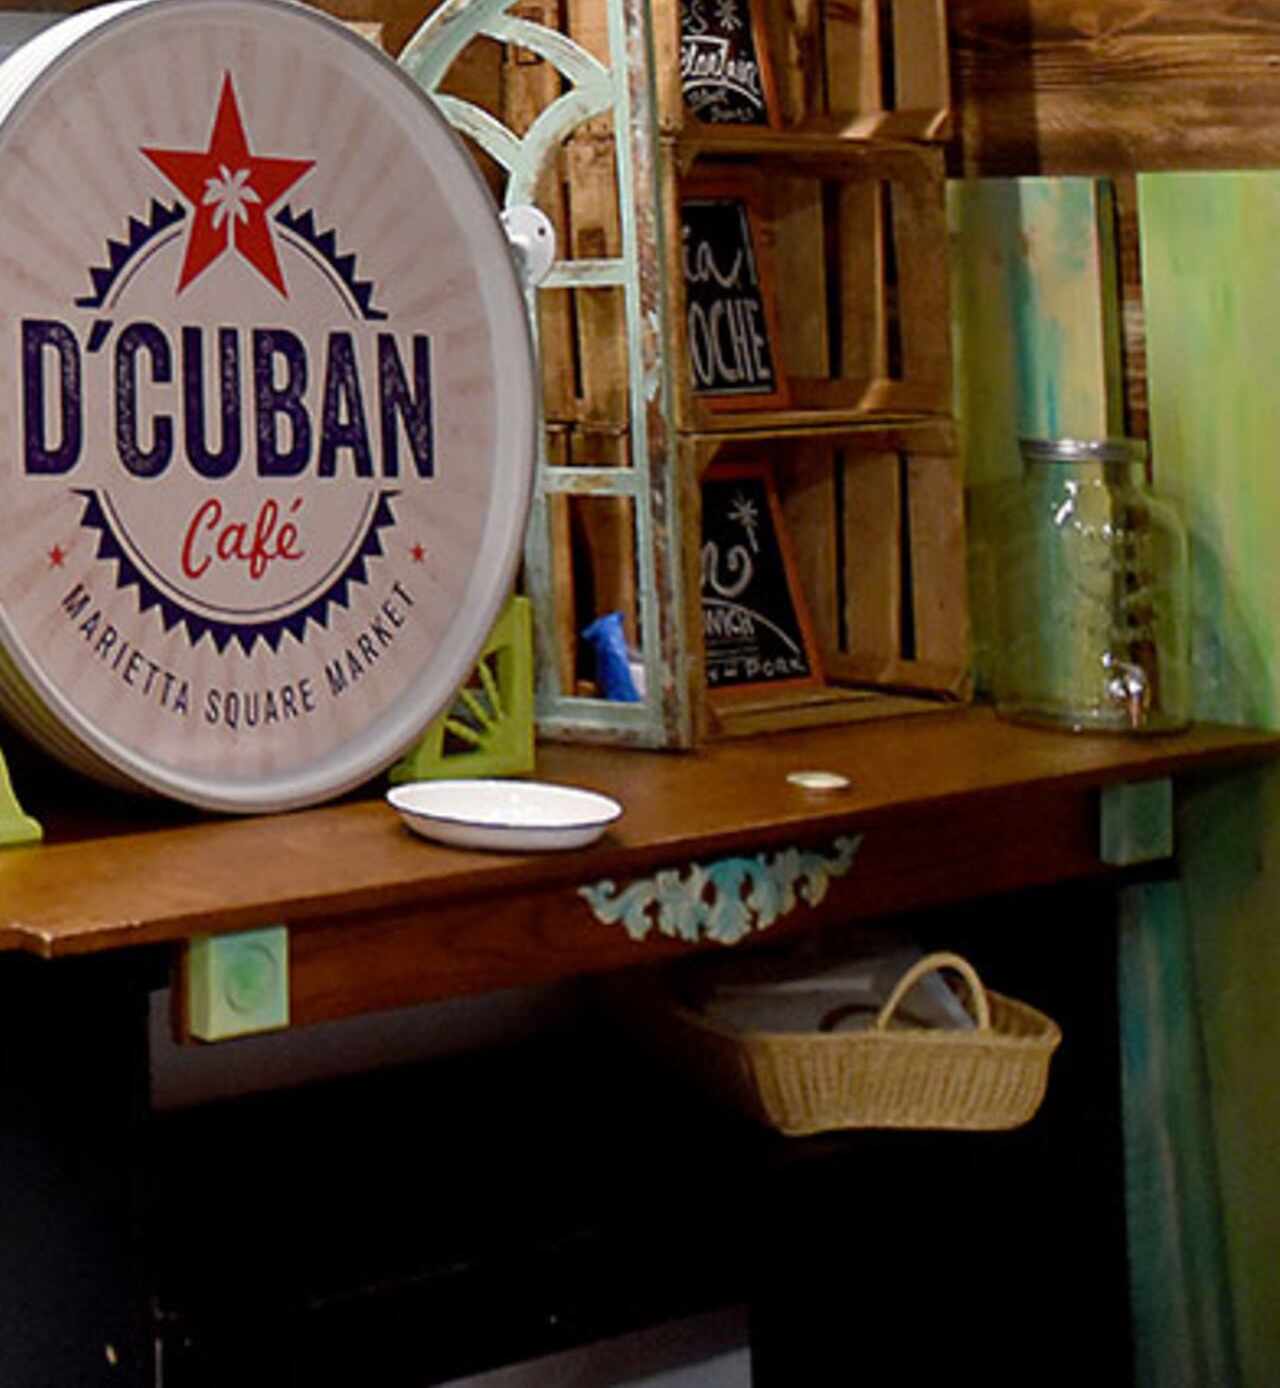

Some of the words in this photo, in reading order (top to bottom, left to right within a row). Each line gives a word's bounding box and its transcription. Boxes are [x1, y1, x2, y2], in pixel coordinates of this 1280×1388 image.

[181, 498, 305, 580] Café
[61, 582, 190, 714] MARIETTA
[205, 676, 317, 729] SQUARE
[323, 580, 417, 695] MARKET
